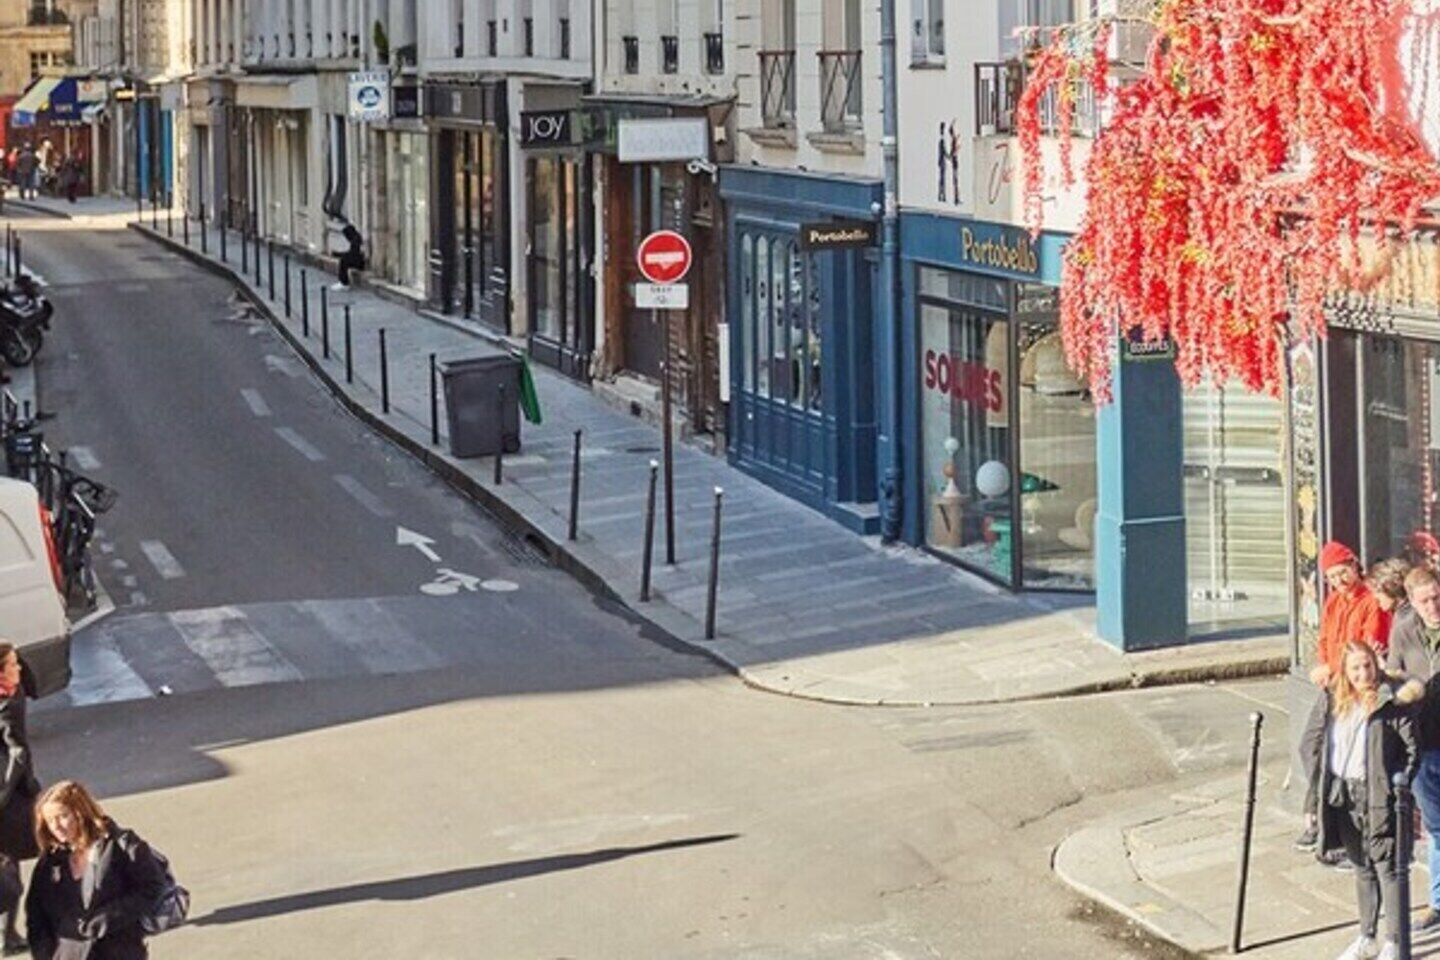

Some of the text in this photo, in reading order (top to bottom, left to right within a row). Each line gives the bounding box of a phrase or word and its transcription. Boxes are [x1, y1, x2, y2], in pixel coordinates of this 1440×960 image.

[529, 116, 565, 140] JOY
[810, 229, 870, 244] Portobello
[962, 227, 1038, 273] Portobello
[925, 350, 1003, 413] SOLDES
